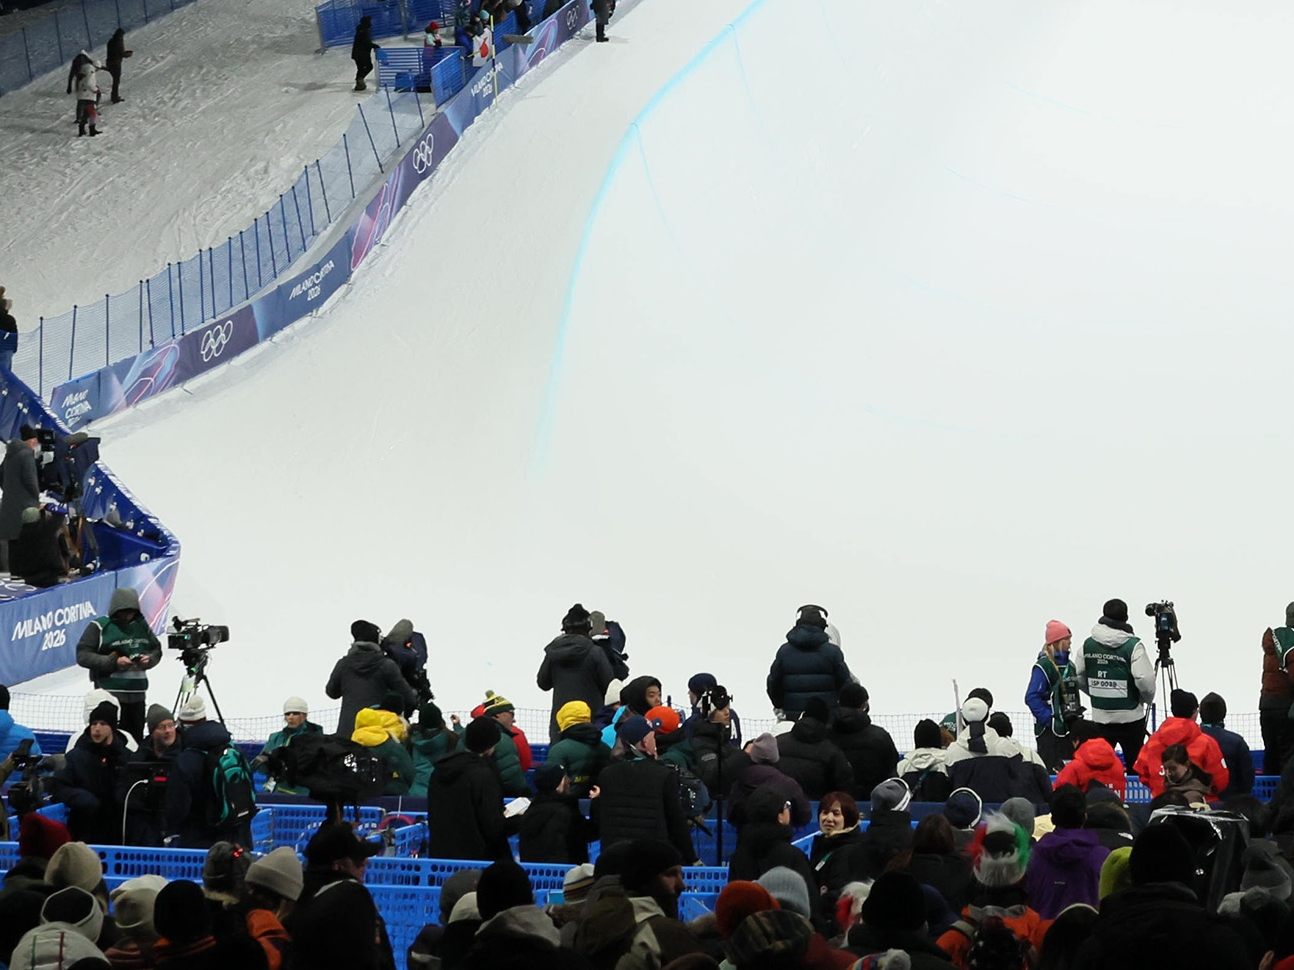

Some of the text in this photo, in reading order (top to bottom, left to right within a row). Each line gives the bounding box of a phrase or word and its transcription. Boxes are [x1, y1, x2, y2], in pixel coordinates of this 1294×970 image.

[11, 600, 97, 642] MILANO CORTINA
[42, 629, 66, 651] 2026
[1098, 670, 1107, 678] RT
